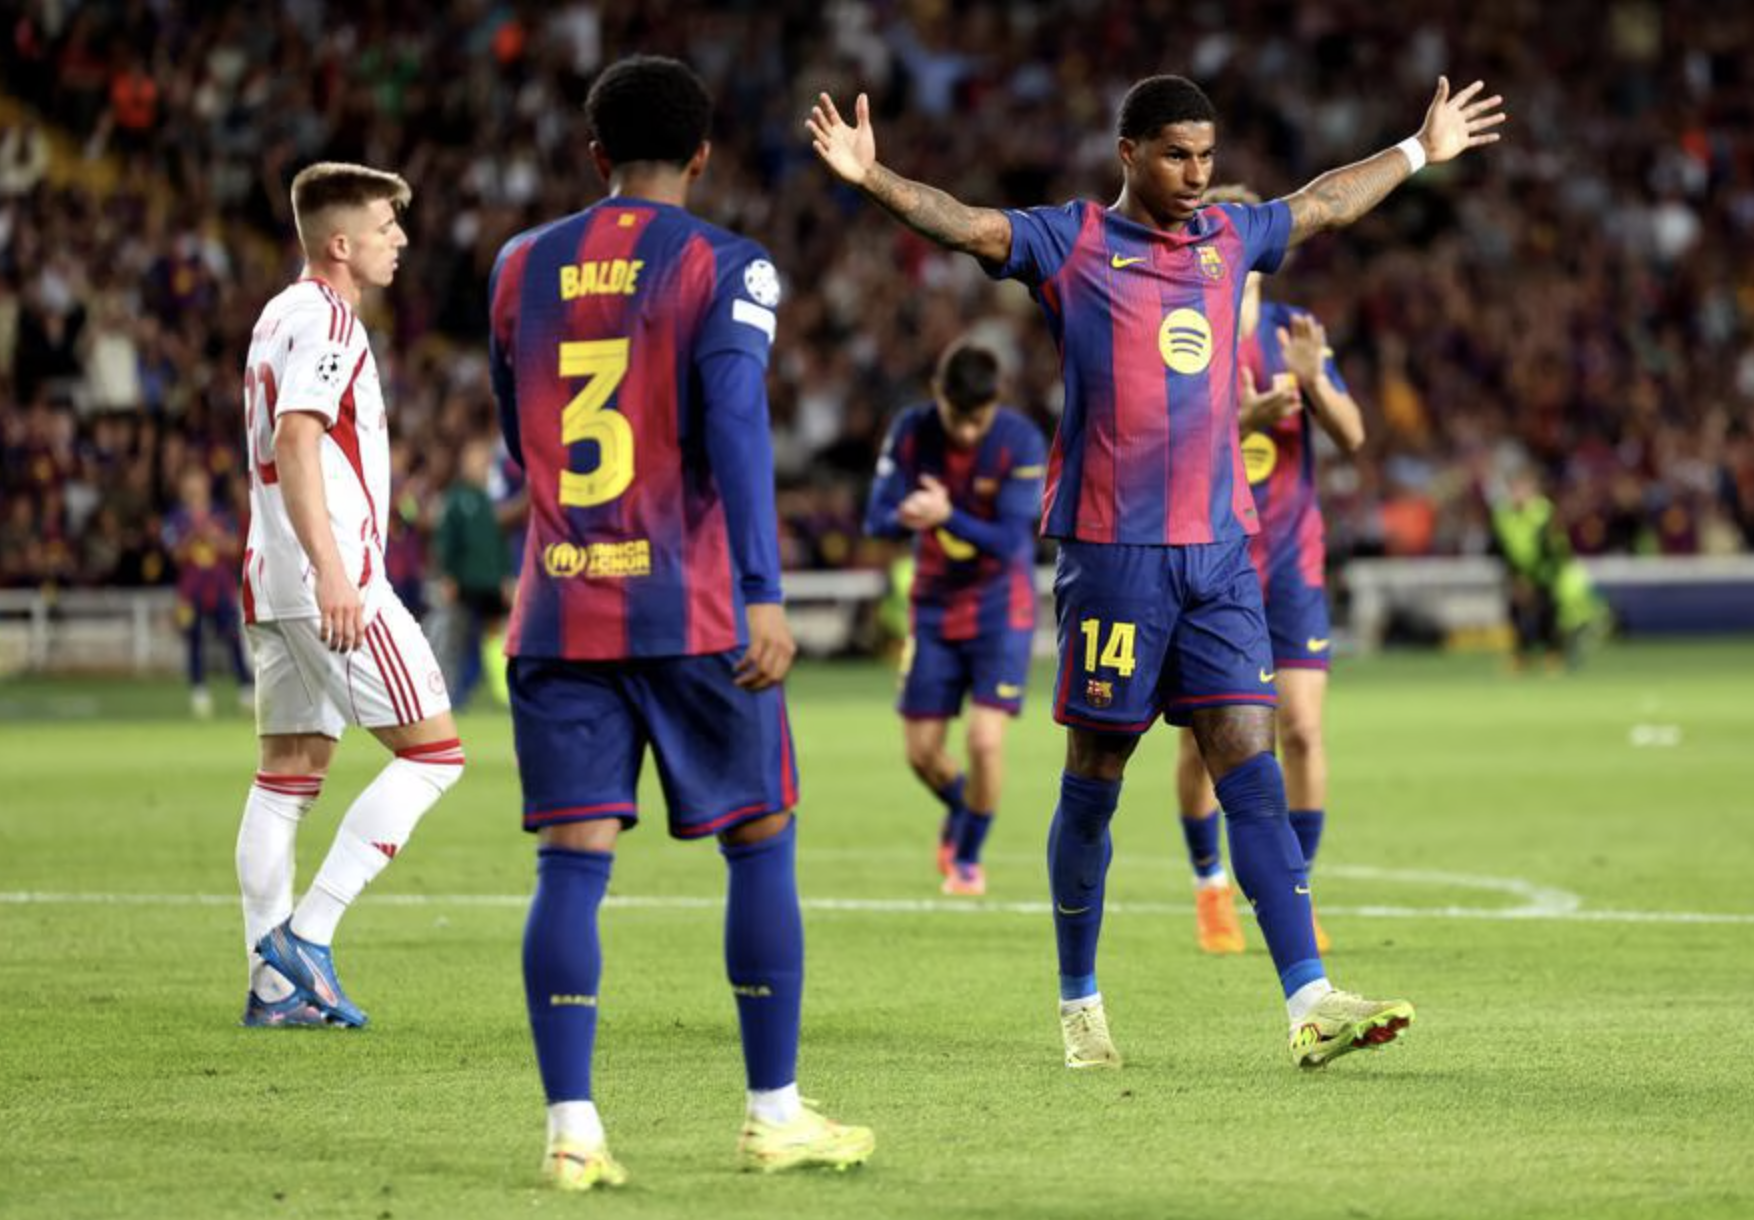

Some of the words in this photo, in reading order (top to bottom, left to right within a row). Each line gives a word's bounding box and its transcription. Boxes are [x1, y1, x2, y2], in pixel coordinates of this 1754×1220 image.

[559, 259, 645, 301] BALDE
[558, 336, 635, 508] 3
[1081, 618, 1136, 677] 14
